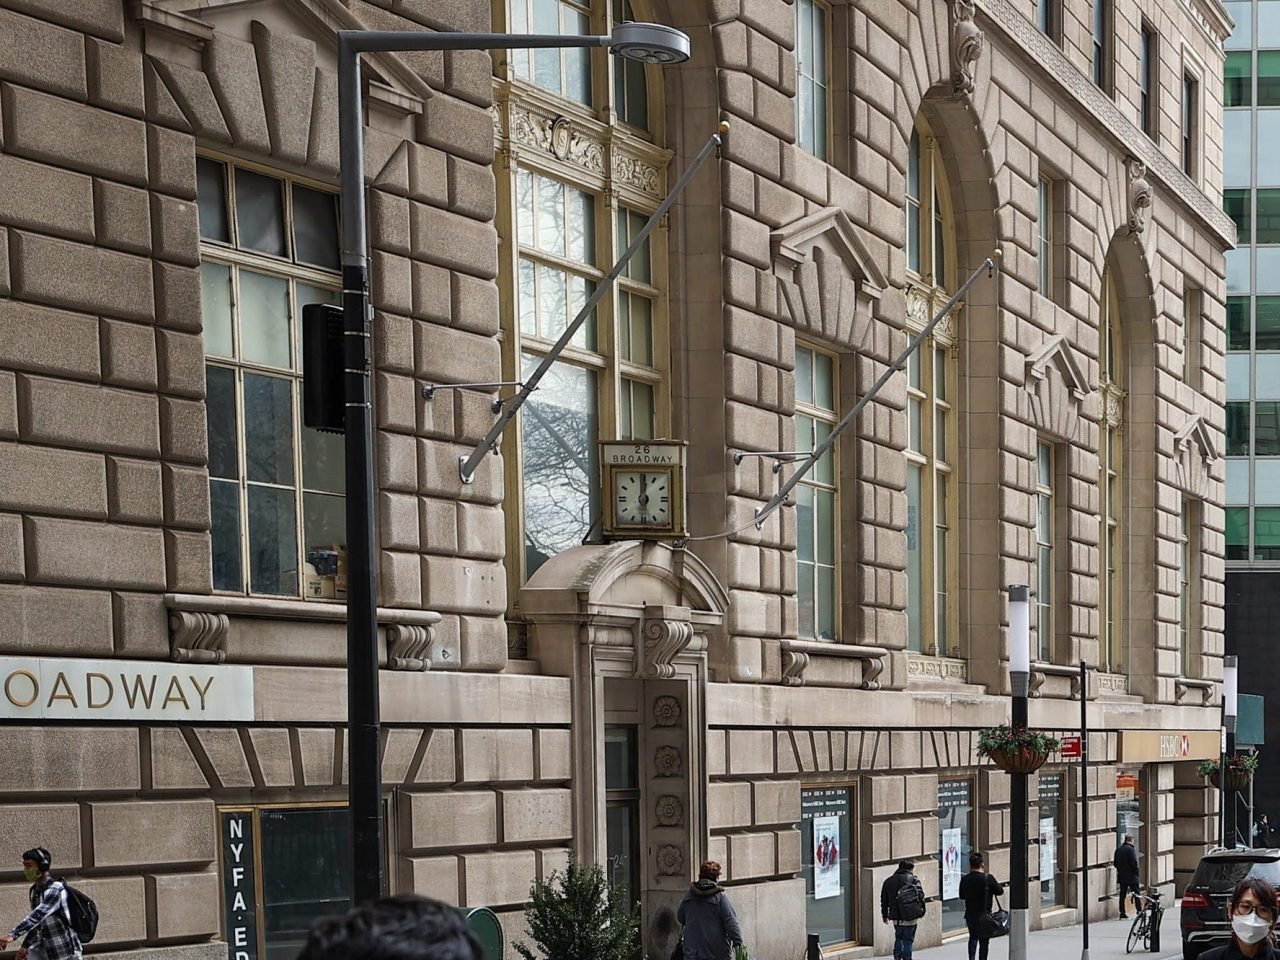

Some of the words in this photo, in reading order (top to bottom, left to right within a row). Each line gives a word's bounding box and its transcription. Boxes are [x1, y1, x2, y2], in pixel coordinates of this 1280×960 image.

[634, 445, 650, 454] 26
[612, 455, 673, 463] BROADWAY
[4, 669, 215, 711] OADWAY
[1160, 735, 1180, 757] HSBC
